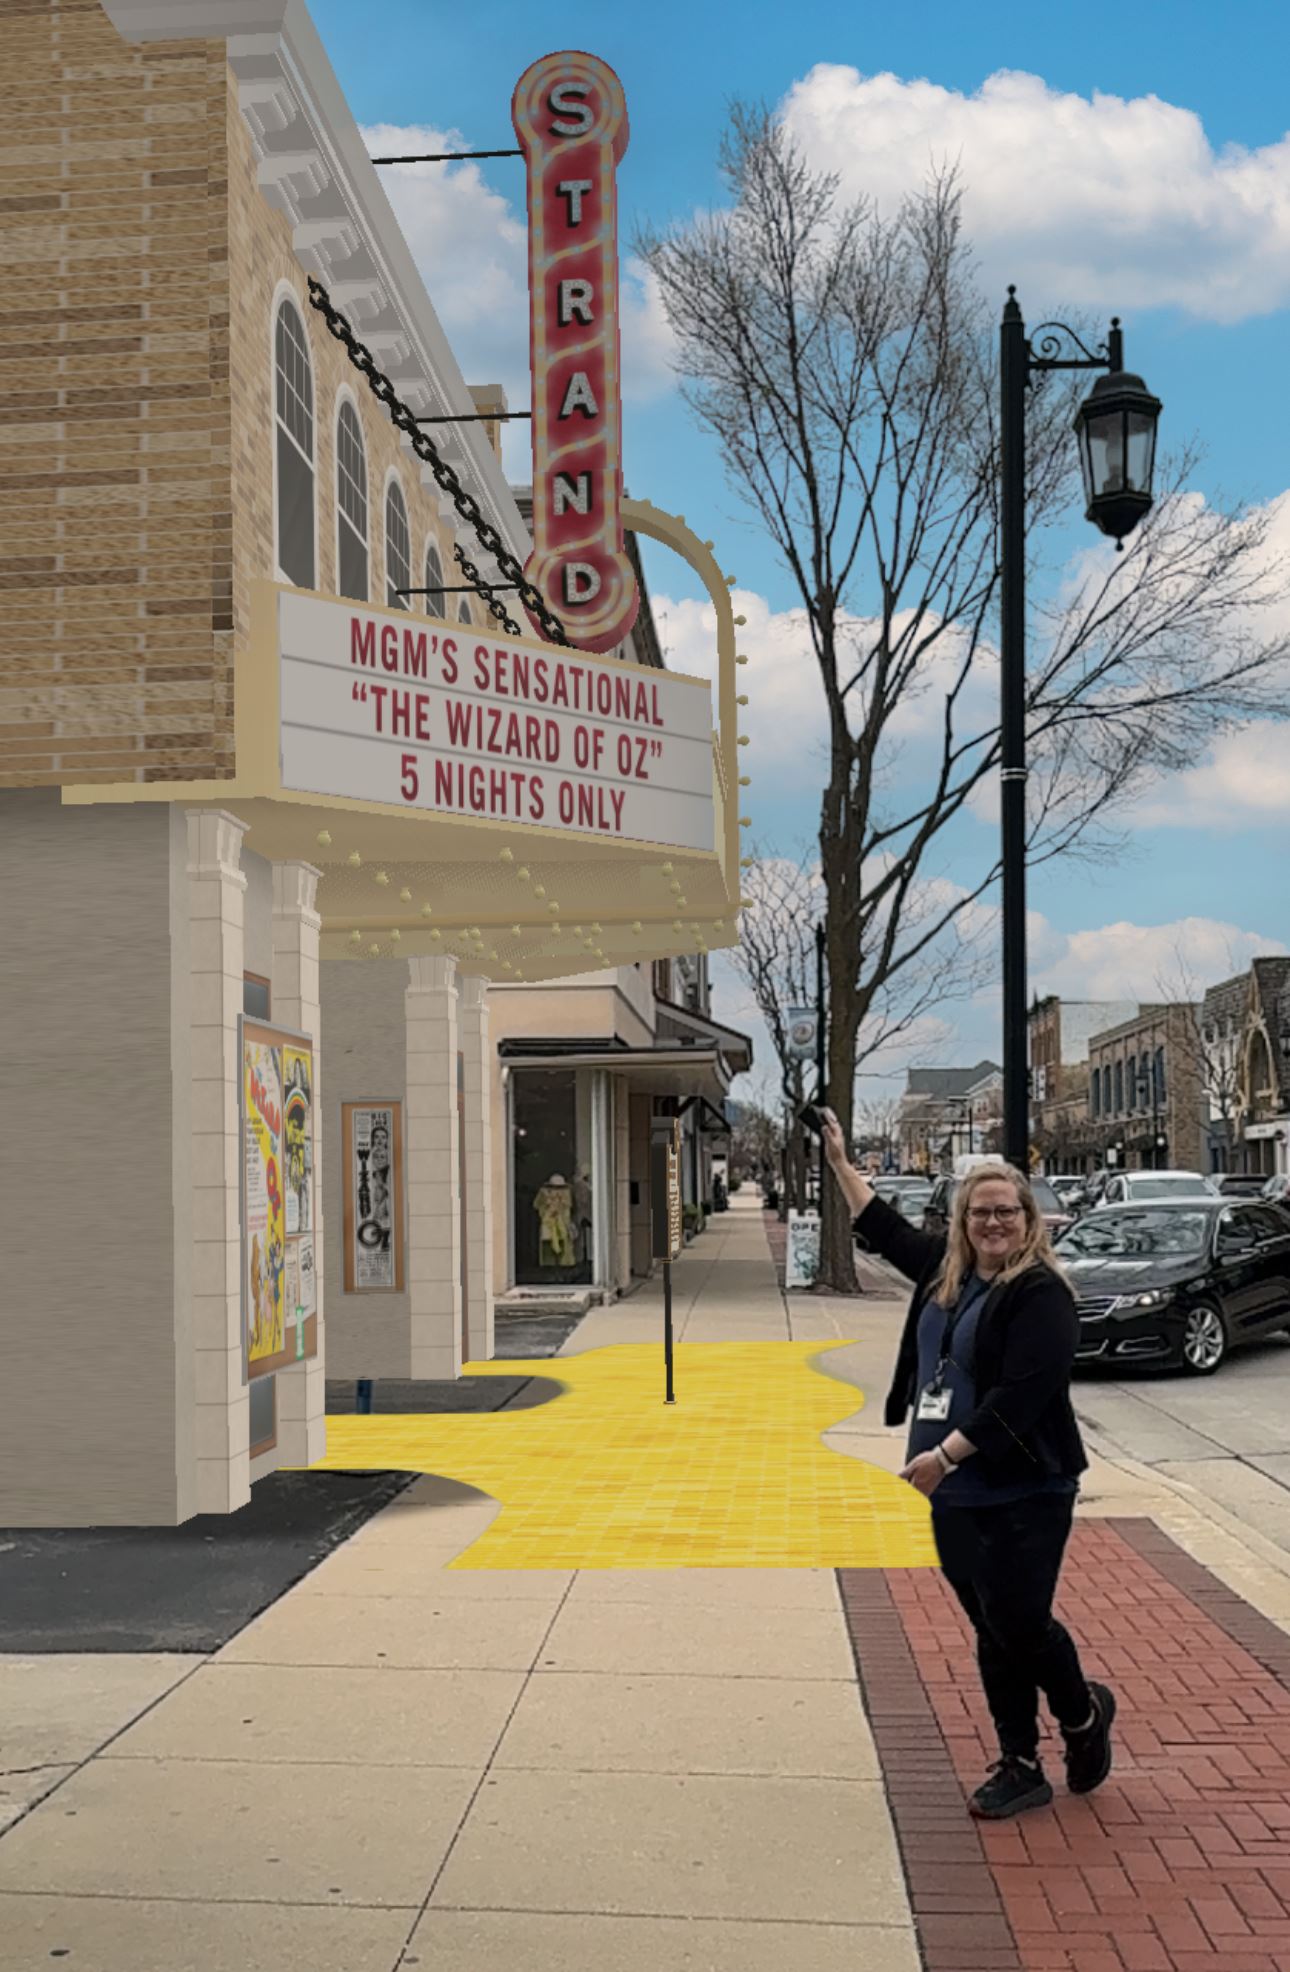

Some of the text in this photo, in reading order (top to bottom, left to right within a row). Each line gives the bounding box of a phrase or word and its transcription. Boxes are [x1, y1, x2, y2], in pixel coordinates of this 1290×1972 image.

[549, 81, 600, 604] STRAND
[350, 617, 664, 727] MGM’S SENSATIONAL
[351, 681, 664, 780] “THE WIZARD OF OZ”
[400, 753, 626, 832] 5 NIGHTS ONLY
